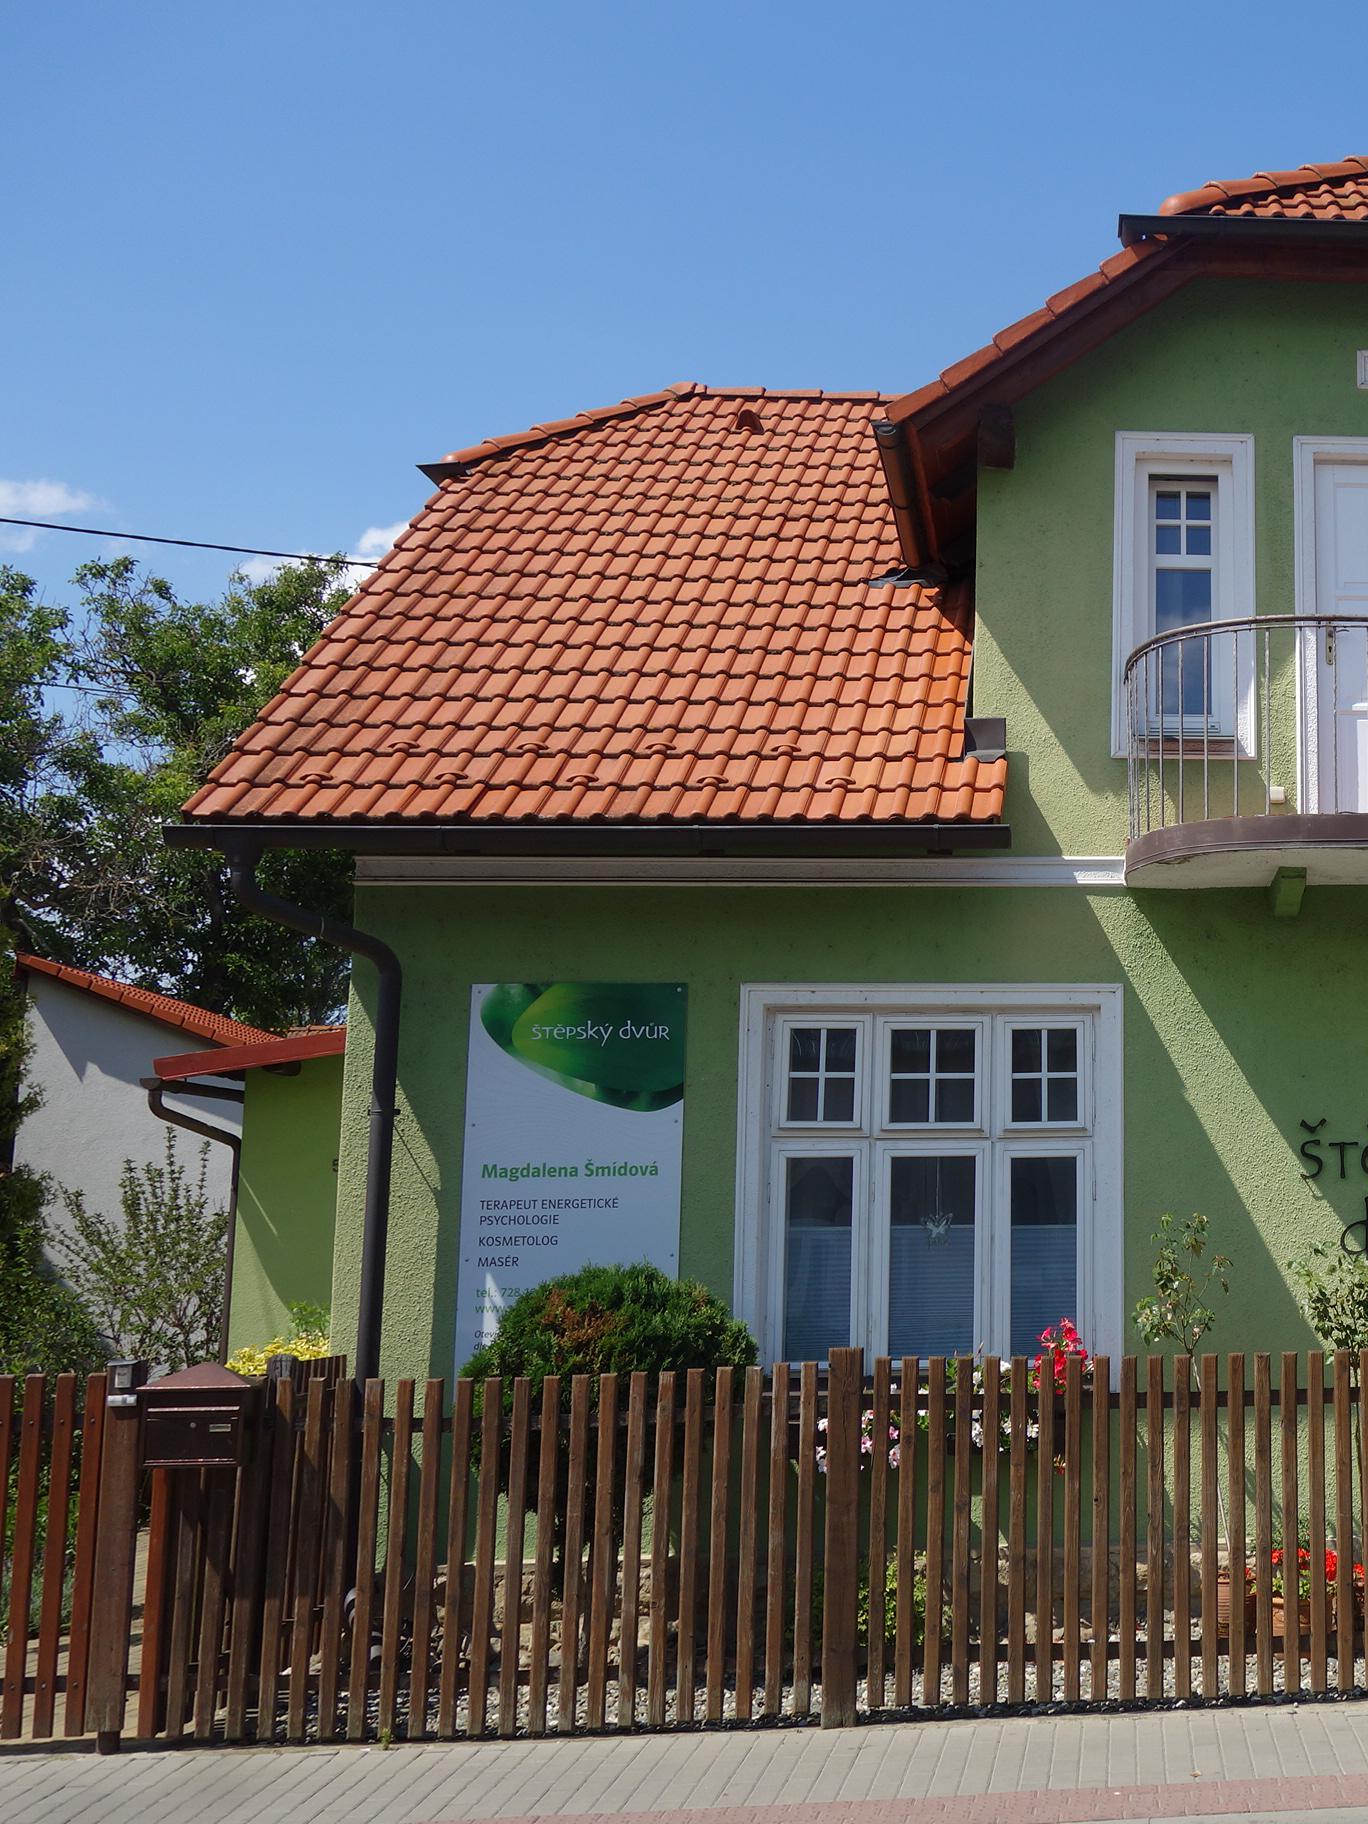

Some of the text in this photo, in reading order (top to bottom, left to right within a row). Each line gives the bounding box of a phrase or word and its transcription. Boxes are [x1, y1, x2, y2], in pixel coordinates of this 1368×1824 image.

[481, 1159, 659, 1182] Magdalena Šmídová
[480, 1197, 619, 1210] TERAPEUT ENERGETICKÉ
[479, 1214, 560, 1226] PSYCHOLOGIE
[478, 1235, 558, 1247] KOSMETOLOG
[477, 1254, 519, 1267] MASÉR
[501, 1287, 521, 1298] 728
